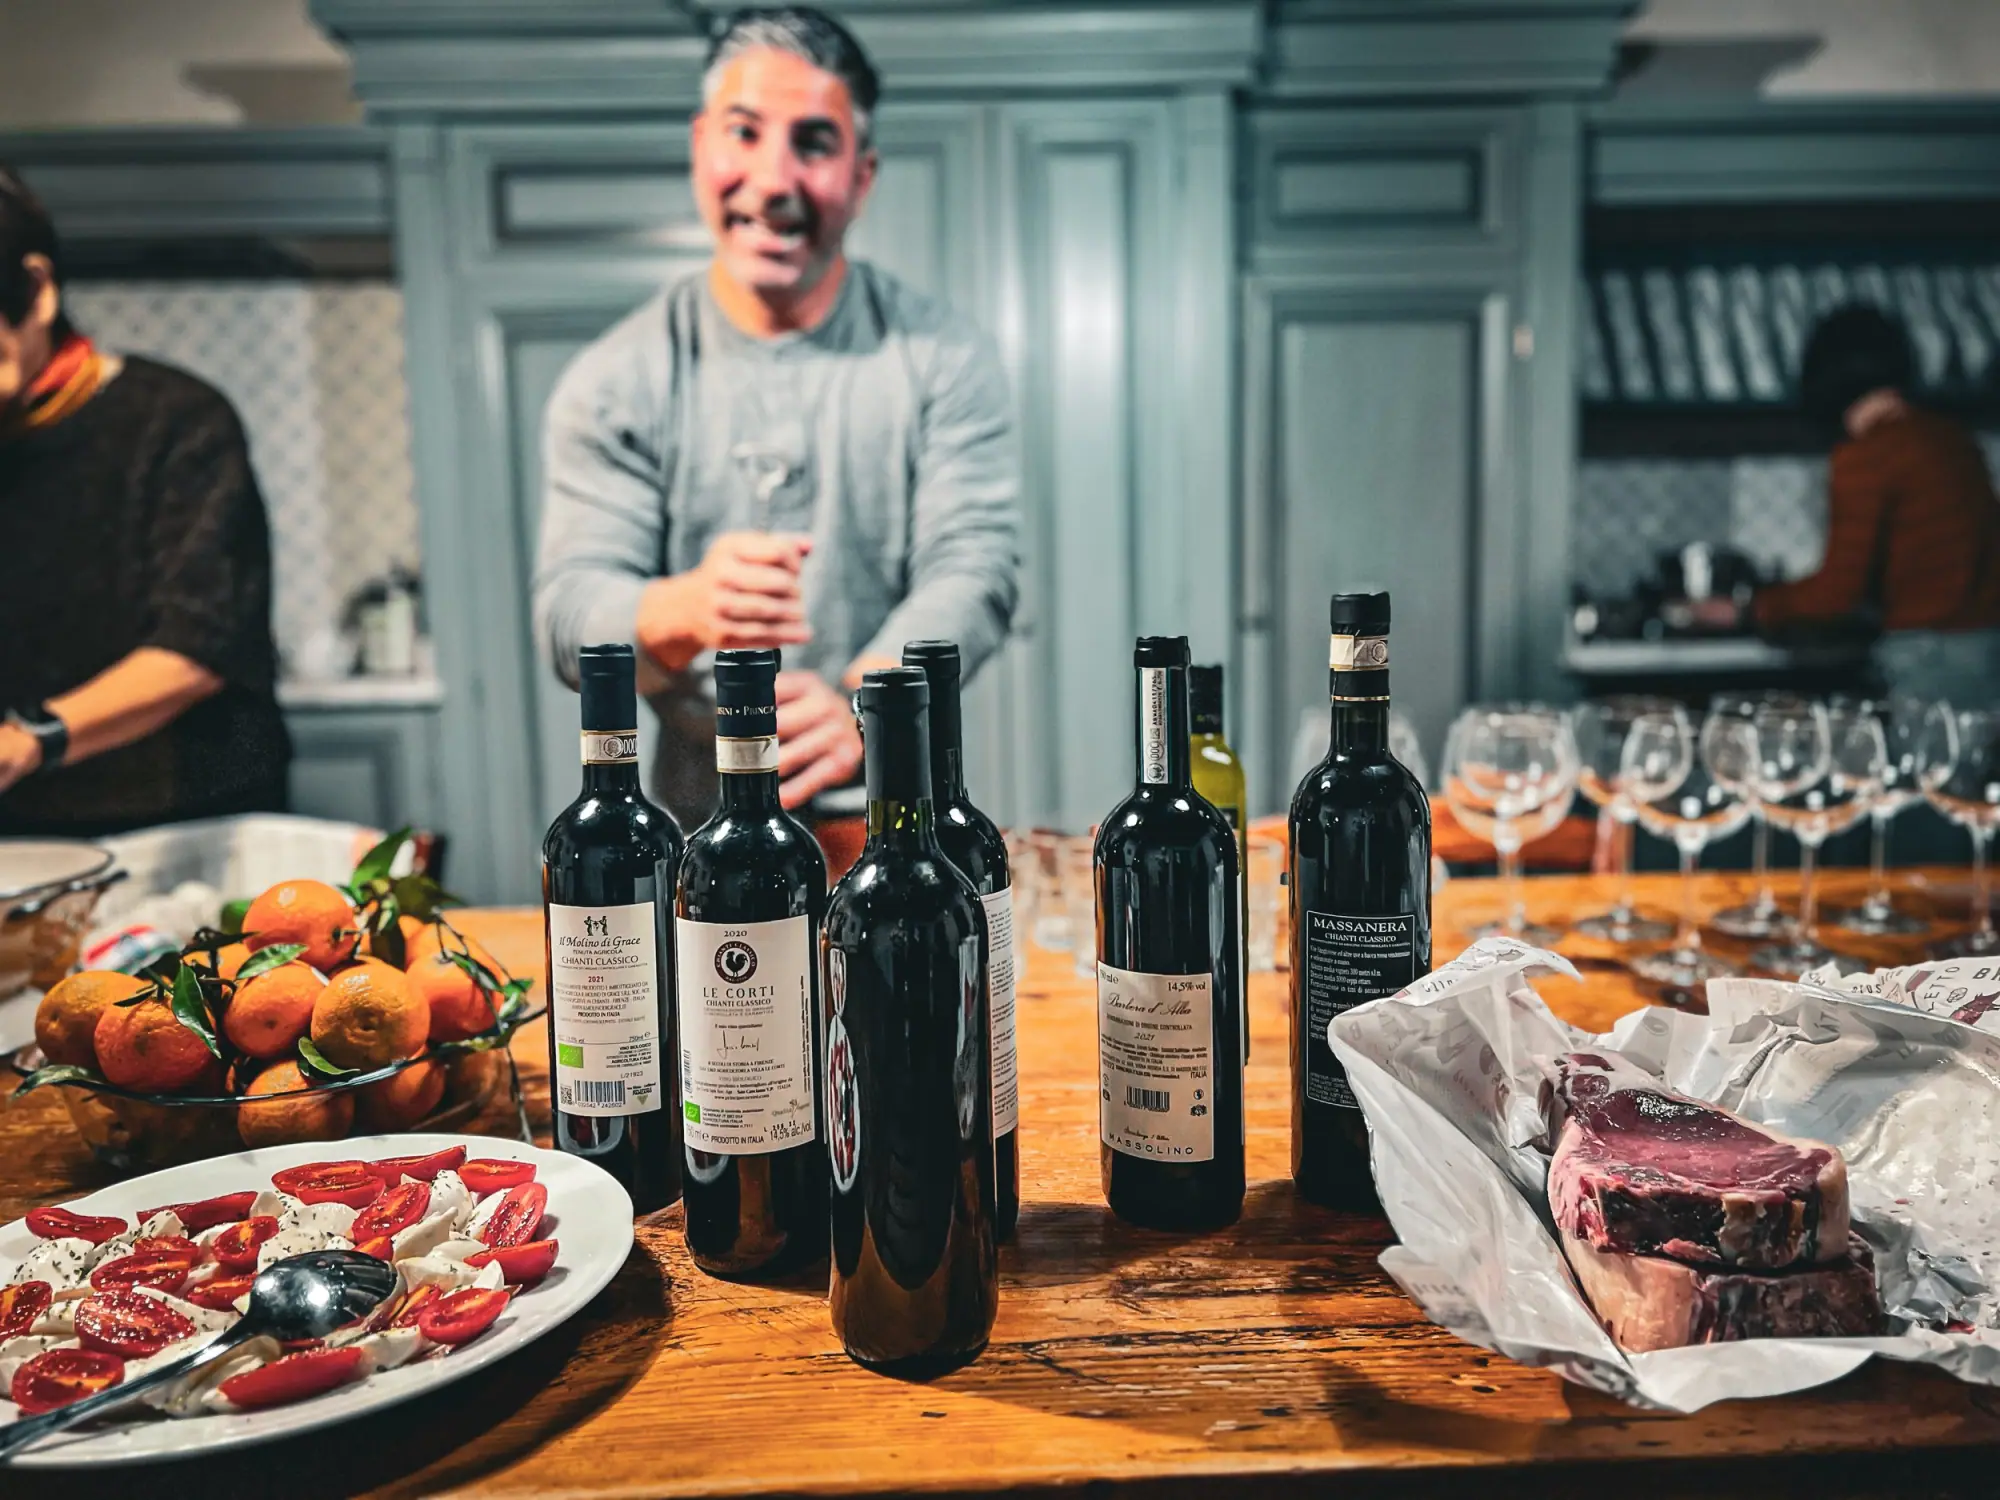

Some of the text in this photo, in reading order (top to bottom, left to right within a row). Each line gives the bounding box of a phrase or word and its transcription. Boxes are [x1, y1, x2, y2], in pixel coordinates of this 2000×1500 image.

[1314, 917, 1407, 933] MASSANERA
[567, 937, 600, 948] Molino
[601, 937, 611, 947] di
[612, 936, 641, 949] Grace
[1325, 932, 1357, 942] CHIANTI
[1359, 935, 1397, 943] CLASSICO
[561, 955, 639, 966] CHIANTI CLASSICO
[703, 985, 774, 999] LE CORTI
[1167, 982, 1206, 992] 14,5% vol
[736, 999, 771, 1007] CLASSICO
[1134, 1032, 1156, 1041] 2021
[1190, 1071, 1207, 1079] ITALIA
[711, 1135, 740, 1144] PRODOTTO
[740, 1136, 747, 1144] IN
[747, 1135, 765, 1144] ITALIA
[770, 1127, 790, 1142] 14,5%
[1109, 1133, 1194, 1155] MASSOLINO
